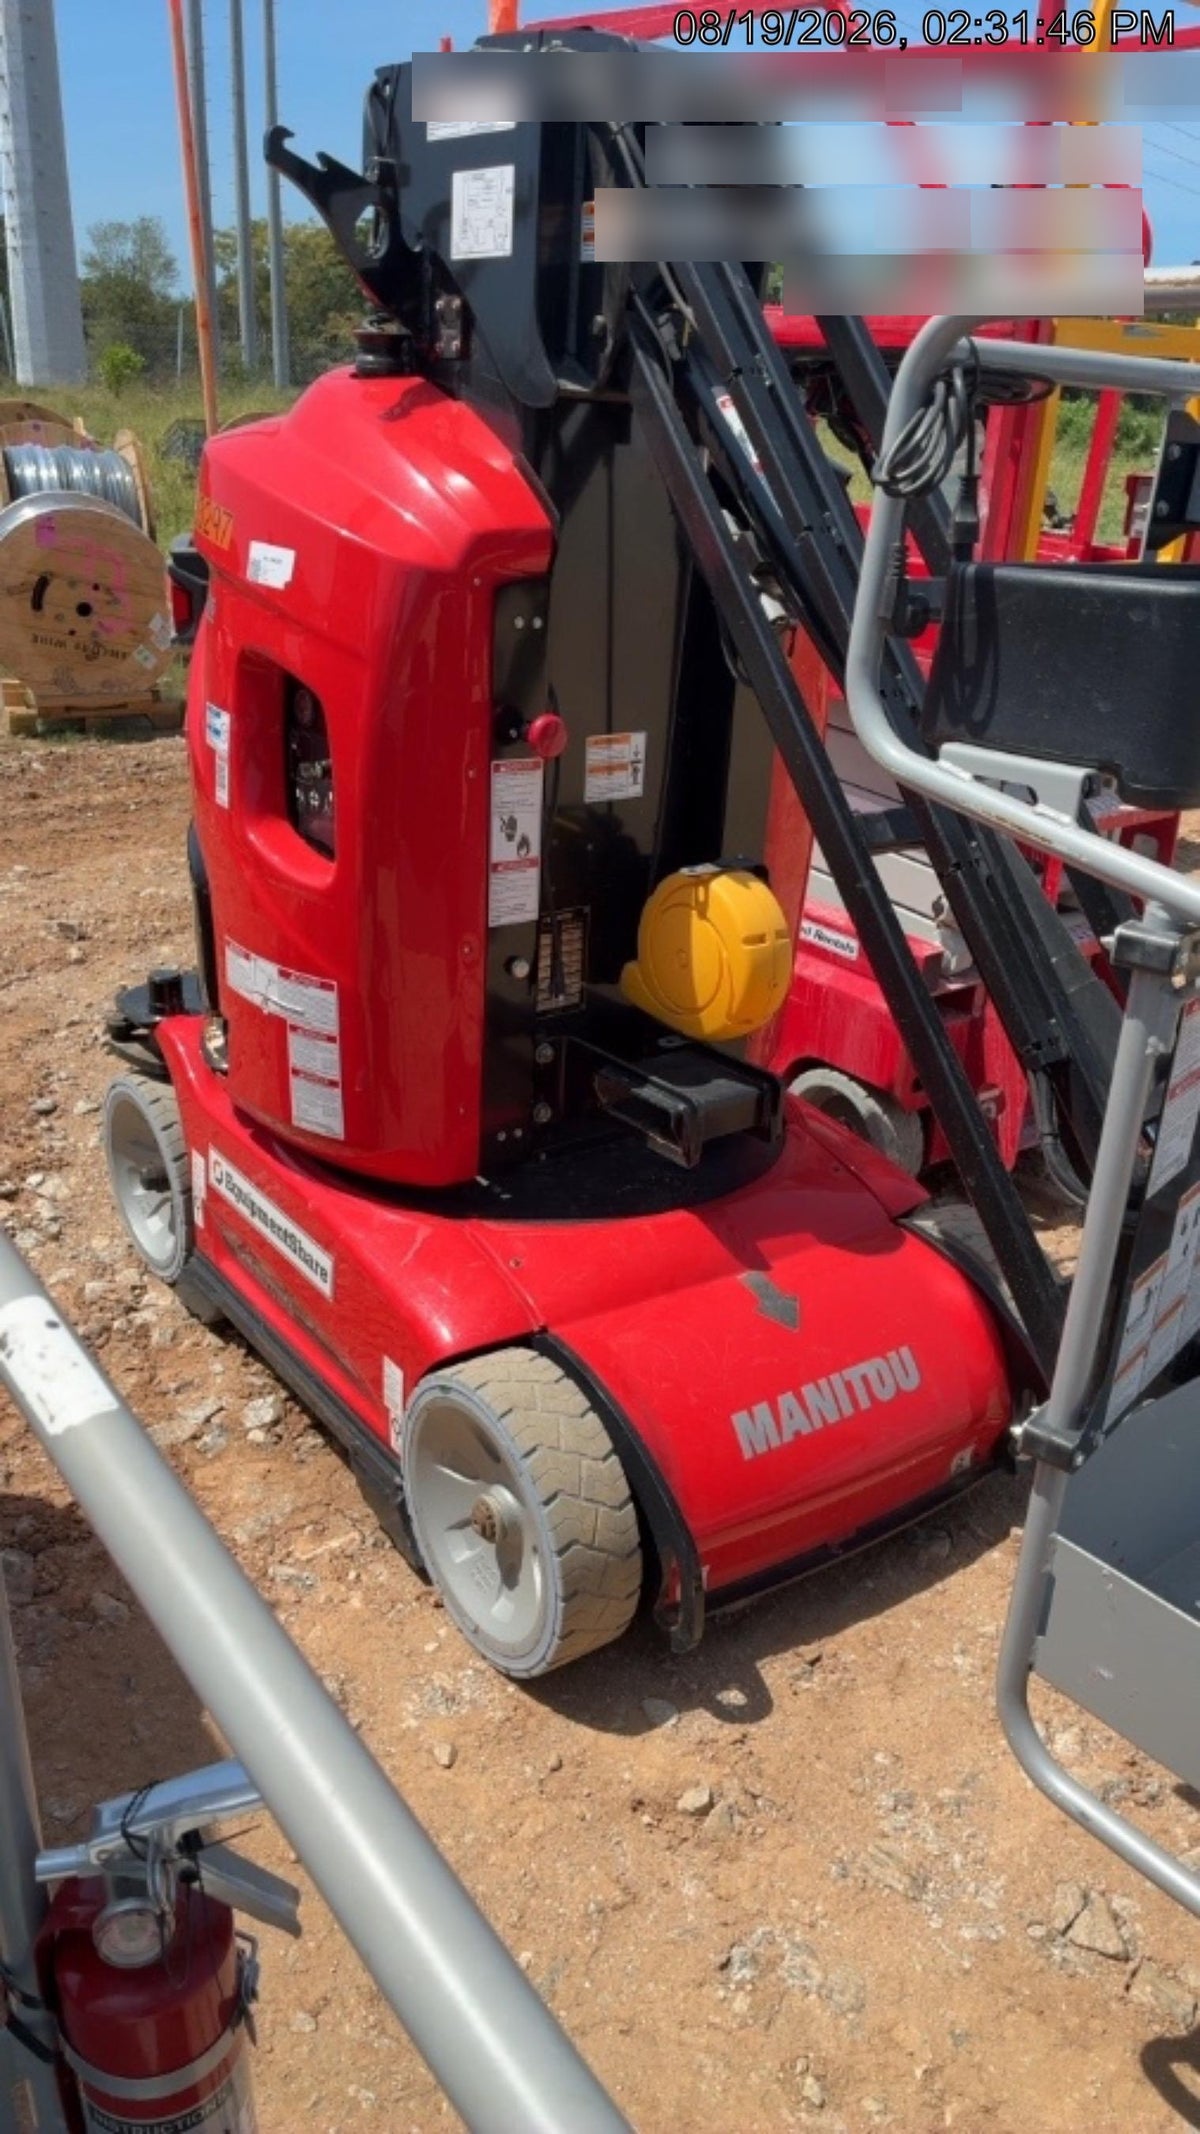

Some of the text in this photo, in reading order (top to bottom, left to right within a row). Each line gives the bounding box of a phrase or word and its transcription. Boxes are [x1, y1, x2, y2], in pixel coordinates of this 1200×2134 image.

[813, 928, 855, 955] Rentals
[224, 1167, 329, 1285] EquipmentShare
[730, 1344, 922, 1461] MANITOU
